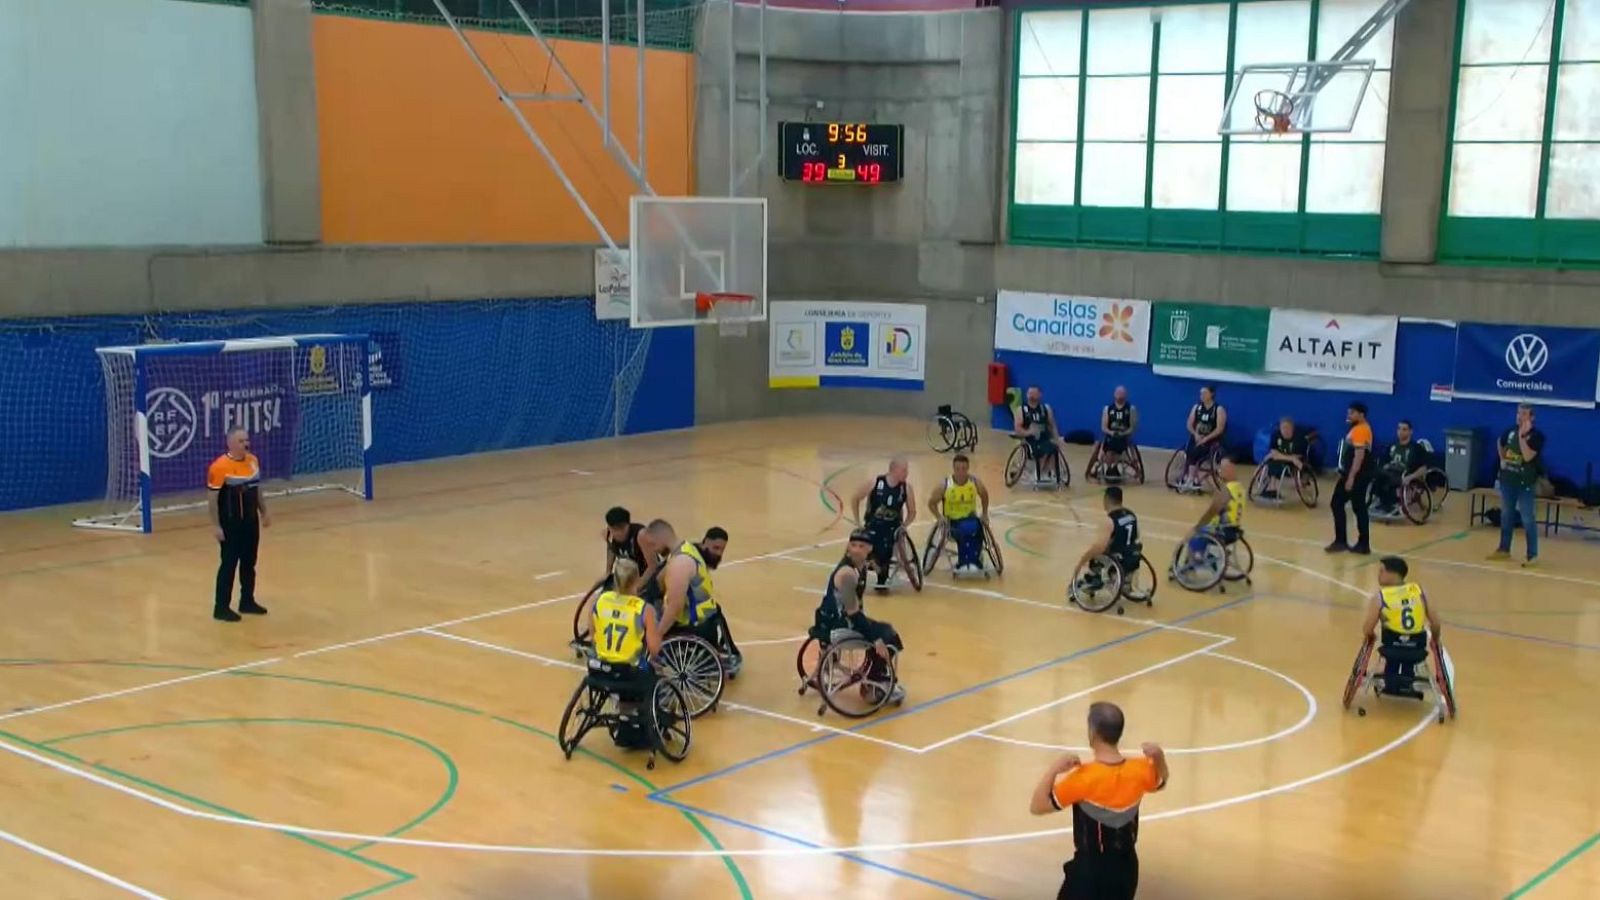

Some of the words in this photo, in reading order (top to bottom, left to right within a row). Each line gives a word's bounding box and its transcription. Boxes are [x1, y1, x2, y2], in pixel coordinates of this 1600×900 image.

[828, 123, 868, 142] 9:56
[837, 154, 846, 168] 3
[802, 162, 825, 181] 39
[857, 164, 880, 182] 49
[1054, 299, 1097, 320] Islas
[1012, 313, 1096, 338] Canarias
[1279, 335, 1382, 360] ALTAFIT
[1496, 378, 1553, 392] Comerciales
[1401, 607, 1415, 630] 6
[603, 622, 628, 652] 17
